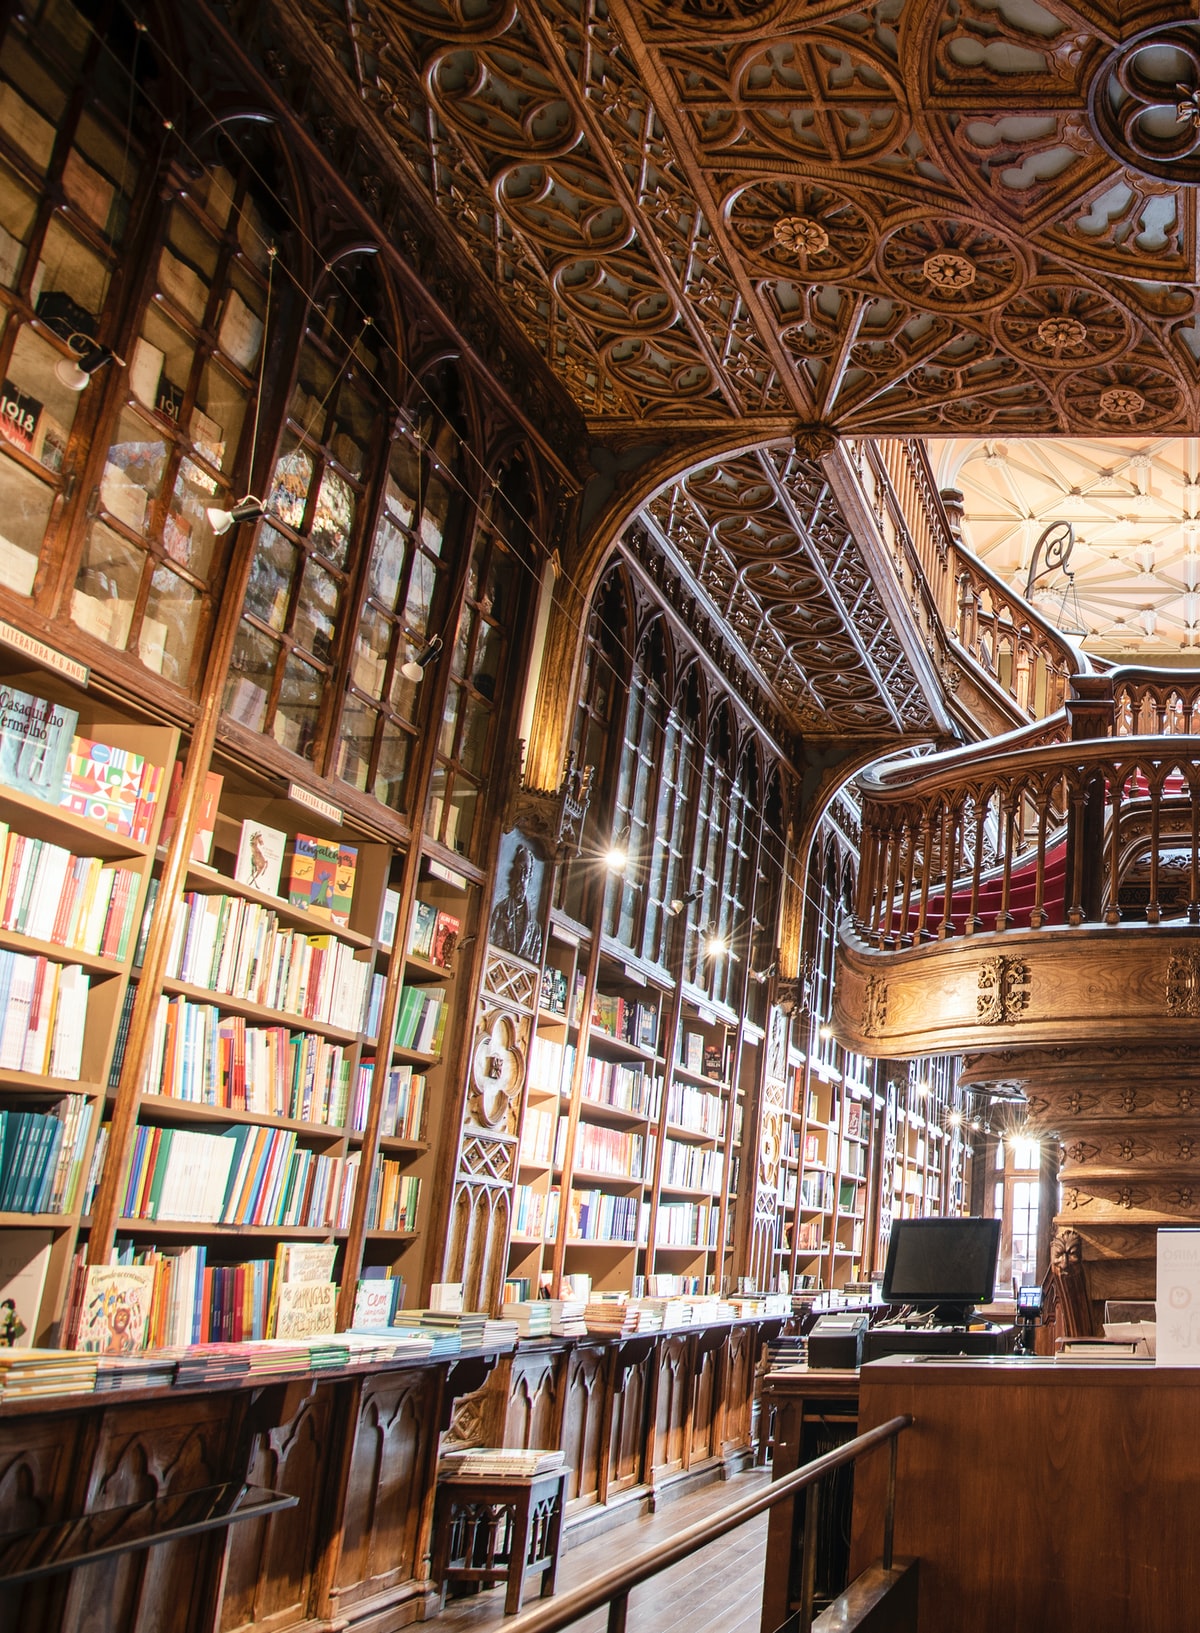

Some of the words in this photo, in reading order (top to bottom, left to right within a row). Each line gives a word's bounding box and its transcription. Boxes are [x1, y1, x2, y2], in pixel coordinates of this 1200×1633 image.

[0, 396, 34, 433] 1918
[160, 395, 180, 419] 191
[1, 625, 49, 661] LITERATURA
[66, 662, 85, 681] ANOS
[292, 786, 319, 808] LITERATURA
